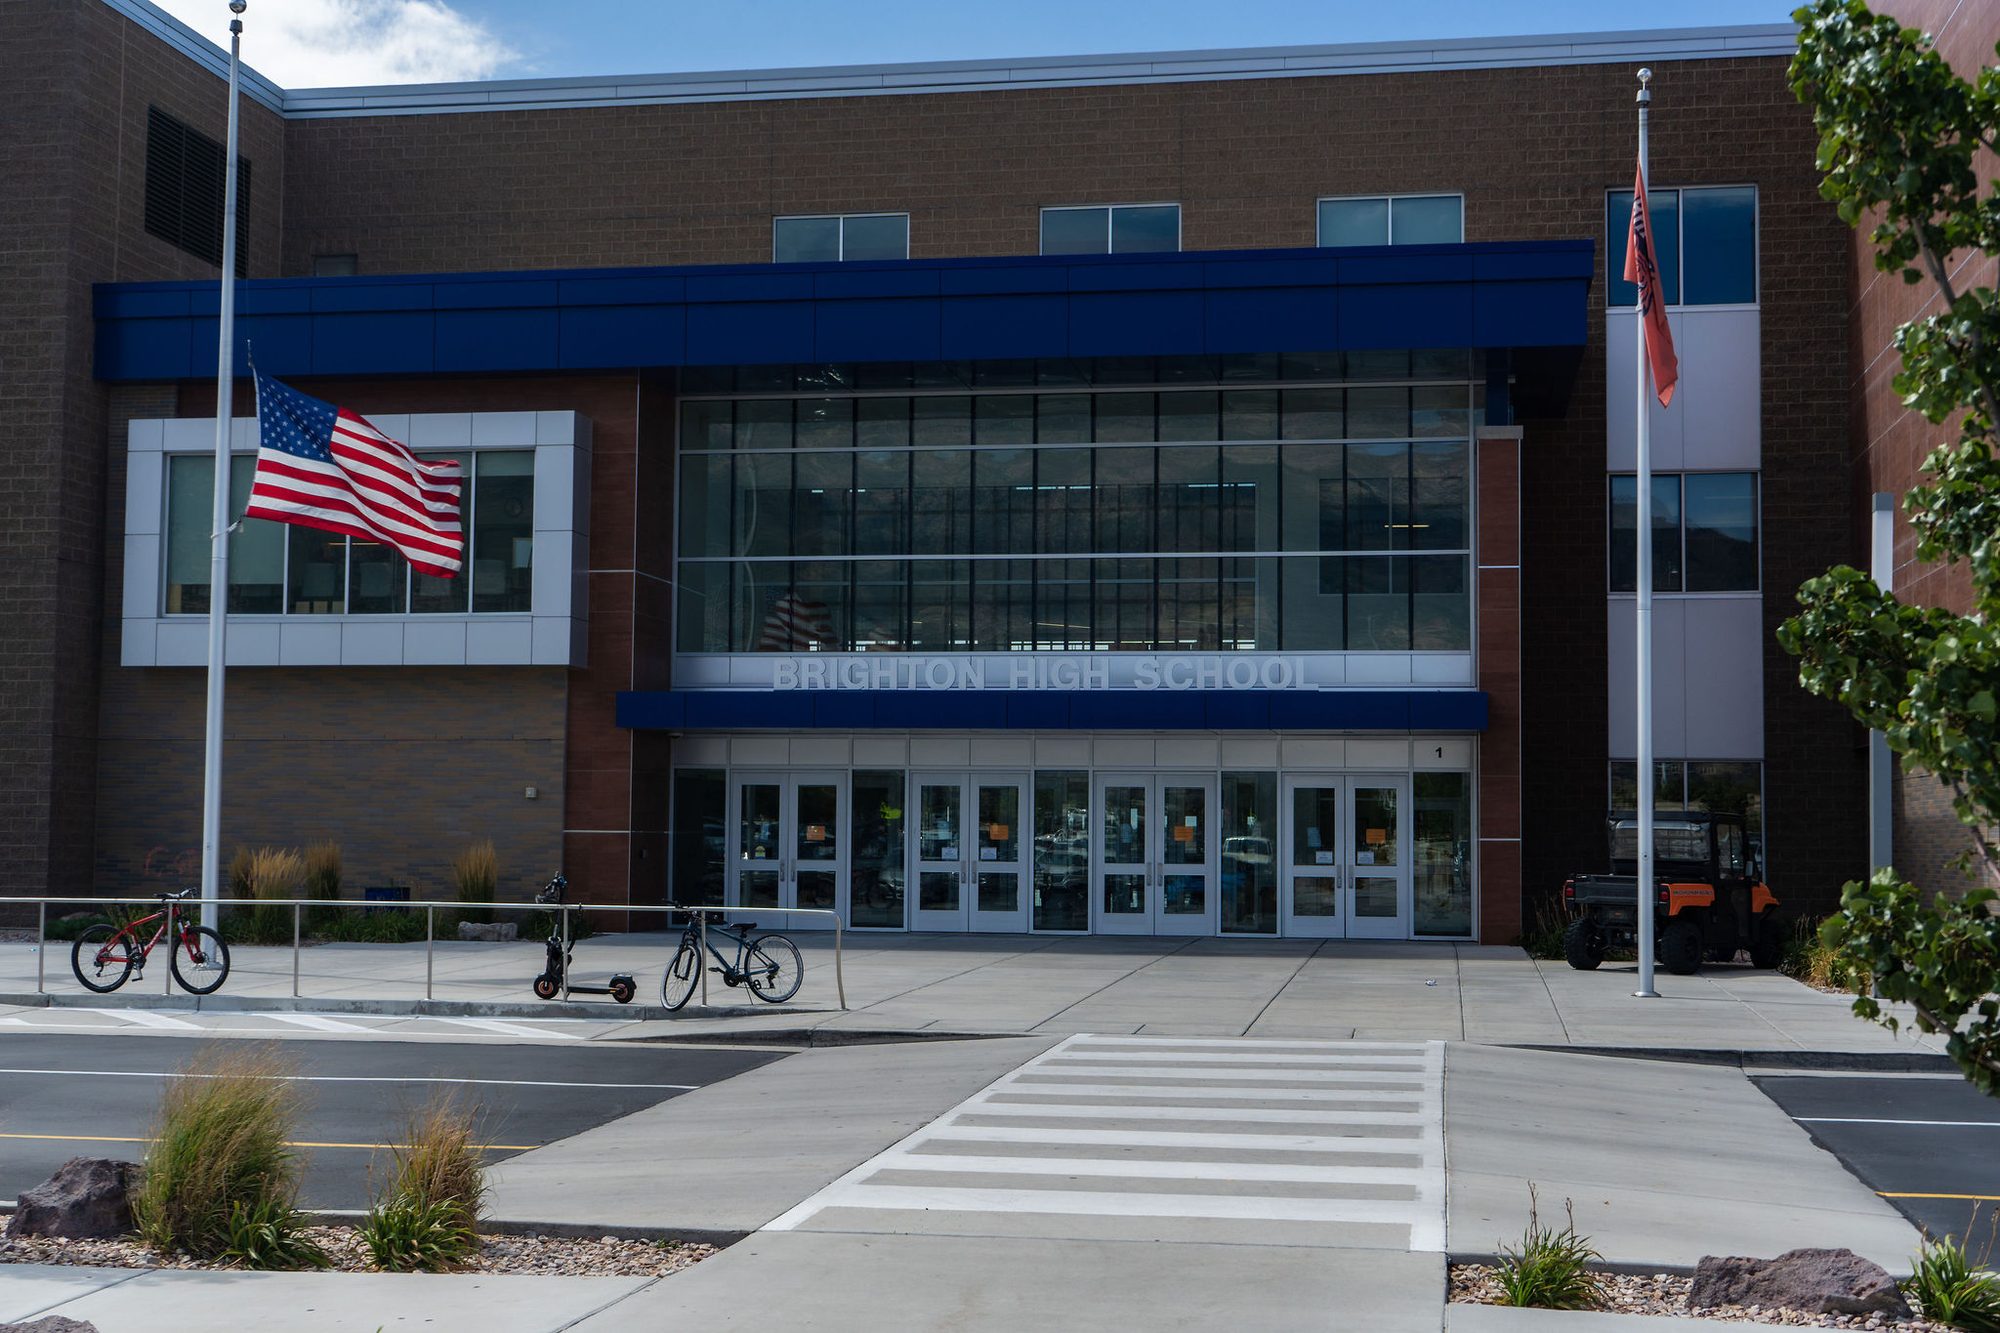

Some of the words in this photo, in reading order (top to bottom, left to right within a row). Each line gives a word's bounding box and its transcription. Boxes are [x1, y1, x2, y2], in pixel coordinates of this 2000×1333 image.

[773, 656, 985, 691] BRIGHTON
[1009, 656, 1109, 691] HIGH
[1133, 656, 1319, 691] SCHOOL
[1435, 746, 1442, 759] 1
